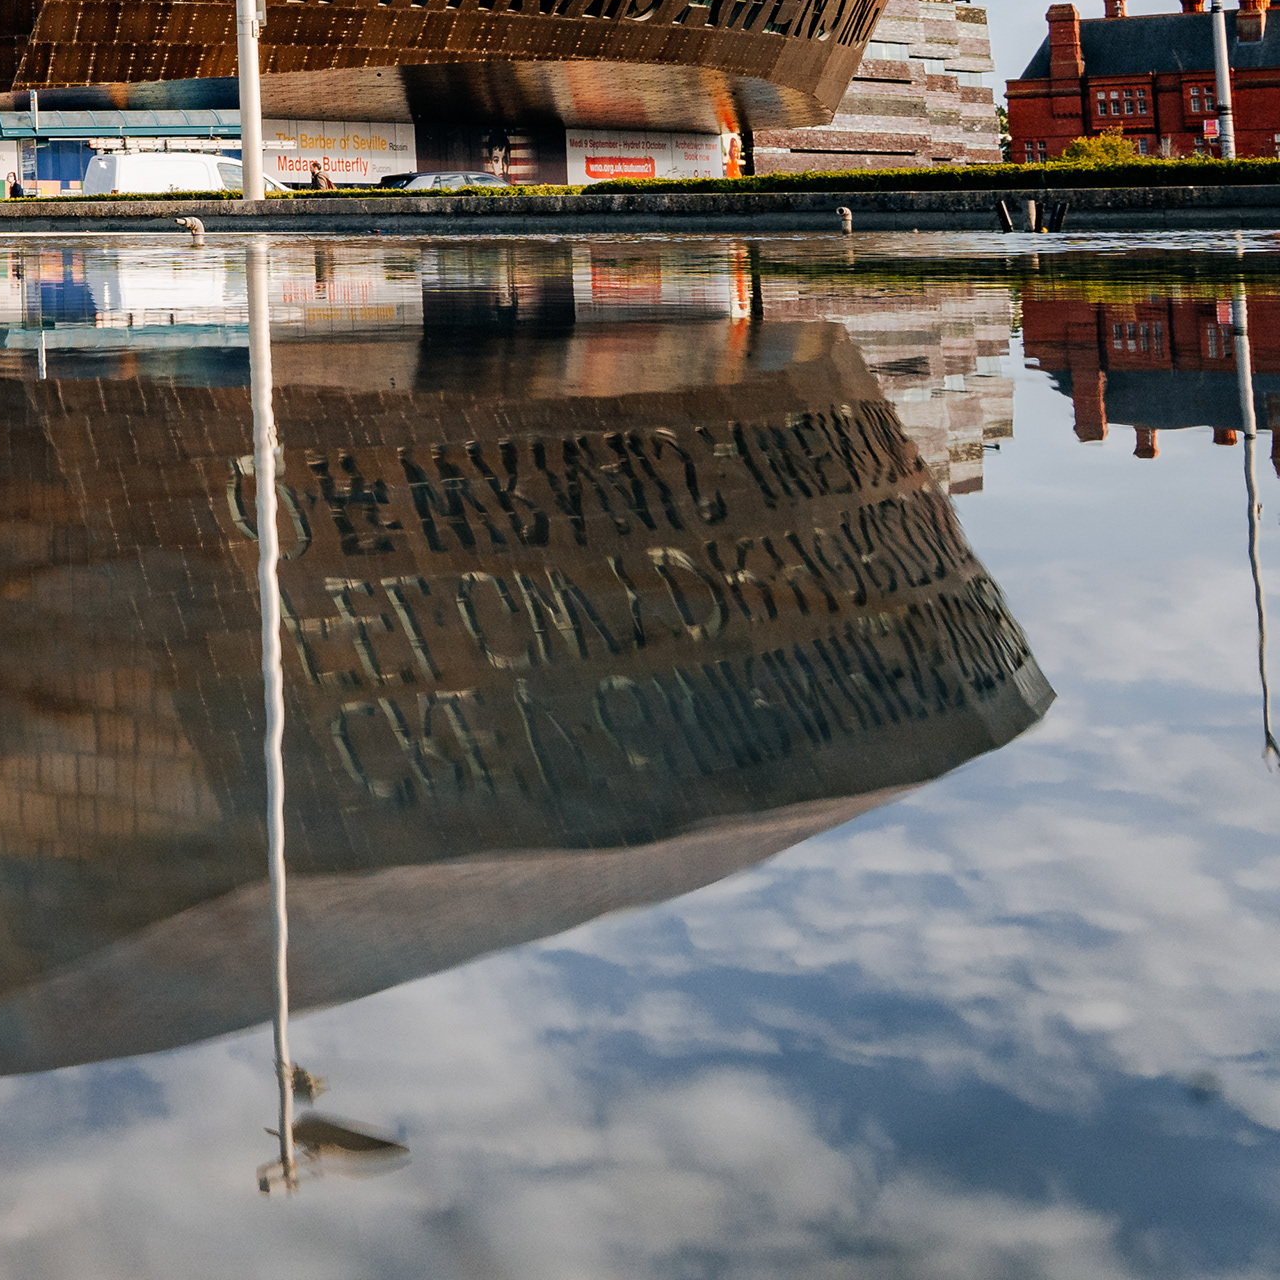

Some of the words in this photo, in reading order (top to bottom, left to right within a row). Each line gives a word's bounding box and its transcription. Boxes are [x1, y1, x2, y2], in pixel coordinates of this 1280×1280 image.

[300, 133, 336, 149] Barber
[340, 134, 350, 150] of
[352, 134, 387, 150] Seville
[589, 140, 618, 149] September
[646, 141, 667, 150] October
[684, 152, 698, 160] Book
[323, 156, 368, 176] Butterfly
